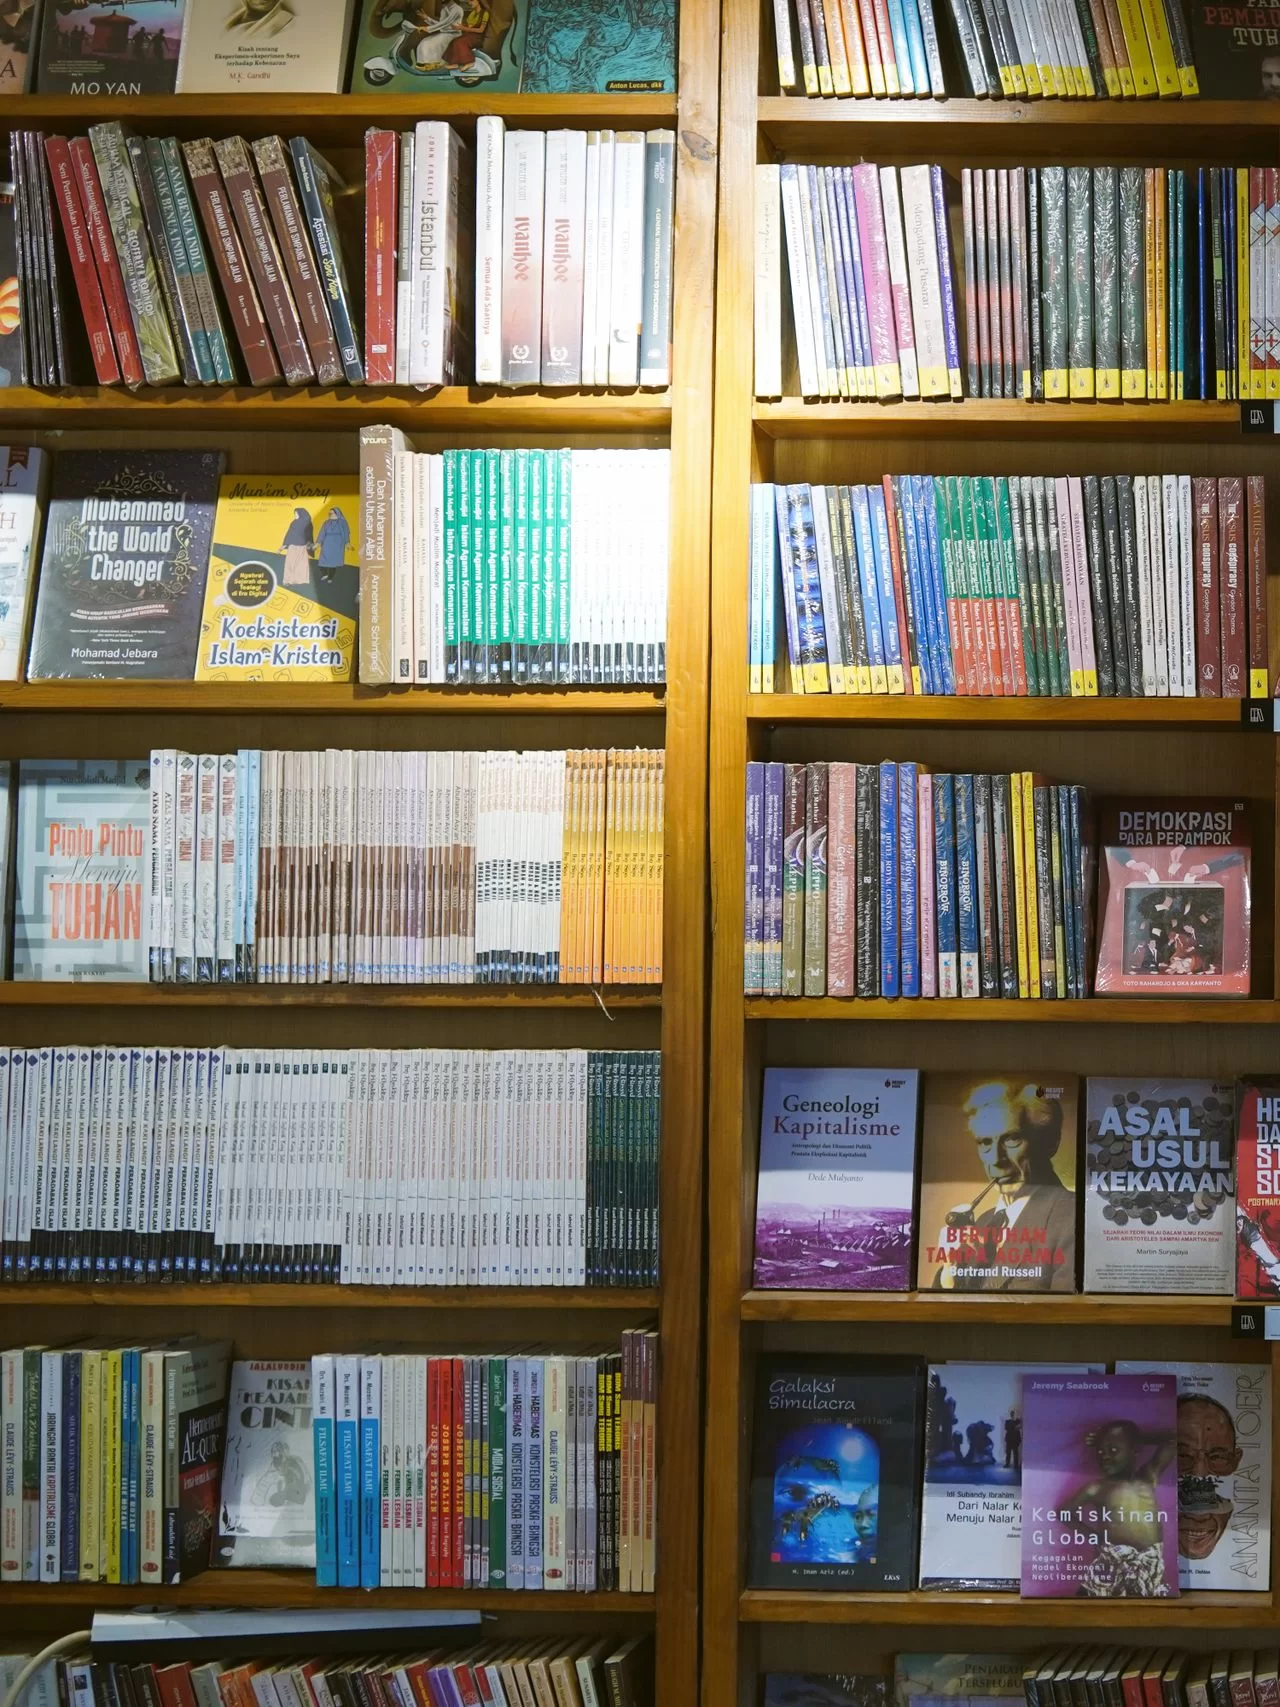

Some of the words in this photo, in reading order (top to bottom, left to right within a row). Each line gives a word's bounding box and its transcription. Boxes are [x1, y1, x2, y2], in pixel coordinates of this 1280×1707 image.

[70, 83, 100, 95] MO
[106, 83, 141, 95] YAN
[420, 201, 438, 271] Istanbul
[184, 235, 201, 268] INDIA
[513, 216, 531, 281] Ivanhoe
[229, 483, 288, 500] Mun'im
[291, 483, 330, 502] Sirry
[377, 480, 385, 500] Dan
[81, 497, 187, 523] Muhammad
[88, 527, 119, 552] the
[123, 526, 172, 553] World
[377, 503, 385, 560] Muhammad
[91, 557, 165, 586] Changer
[221, 618, 338, 639] Koeksistensi
[71, 648, 119, 659] Mohamad
[122, 648, 158, 659] Jebara
[209, 645, 343, 667] Islam-Kristen
[1119, 811, 1232, 831] DEMOKRASI
[50, 823, 93, 857] Pintu
[100, 823, 143, 856] Pintu
[1119, 832, 1153, 845] PARA
[1157, 832, 1232, 845] PERAMPOK
[938, 859, 948, 913] BINORROW
[50, 882, 142, 940] TUHAN
[783, 1095, 880, 1118] Geneologi
[773, 1116, 901, 1140] Kapitalisme
[1097, 1107, 1200, 1136] ASAL
[1132, 1140, 1230, 1168] USUL
[1091, 1171, 1233, 1193] KEKAYAAN
[946, 1226, 1047, 1243] BERTUHAN
[926, 1247, 988, 1264] TANPA
[996, 1247, 1065, 1264] AGAMA
[950, 1266, 998, 1278] Bertrand
[1001, 1267, 1042, 1278] Russell
[769, 1379, 836, 1393] Galaksi
[1032, 1382, 1064, 1390] Jeremy
[769, 1396, 856, 1410] Simulacra
[512, 1394, 521, 1438] HABERMAS
[493, 1448, 502, 1473] MODAL
[512, 1442, 523, 1491] KONSTELASI
[492, 1476, 502, 1501] SOSIAL
[957, 1491, 986, 1499] Subandy
[958, 1502, 978, 1511] Dari
[982, 1502, 1009, 1511] Nalar
[1032, 1506, 1168, 1522] Kemiskinan
[946, 1513, 984, 1524] Menuju
[988, 1514, 1015, 1524] Nalar
[1230, 1463, 1260, 1579] ANANTA
[1032, 1530, 1112, 1545] Global
[1032, 1554, 1083, 1562] Kegagalan
